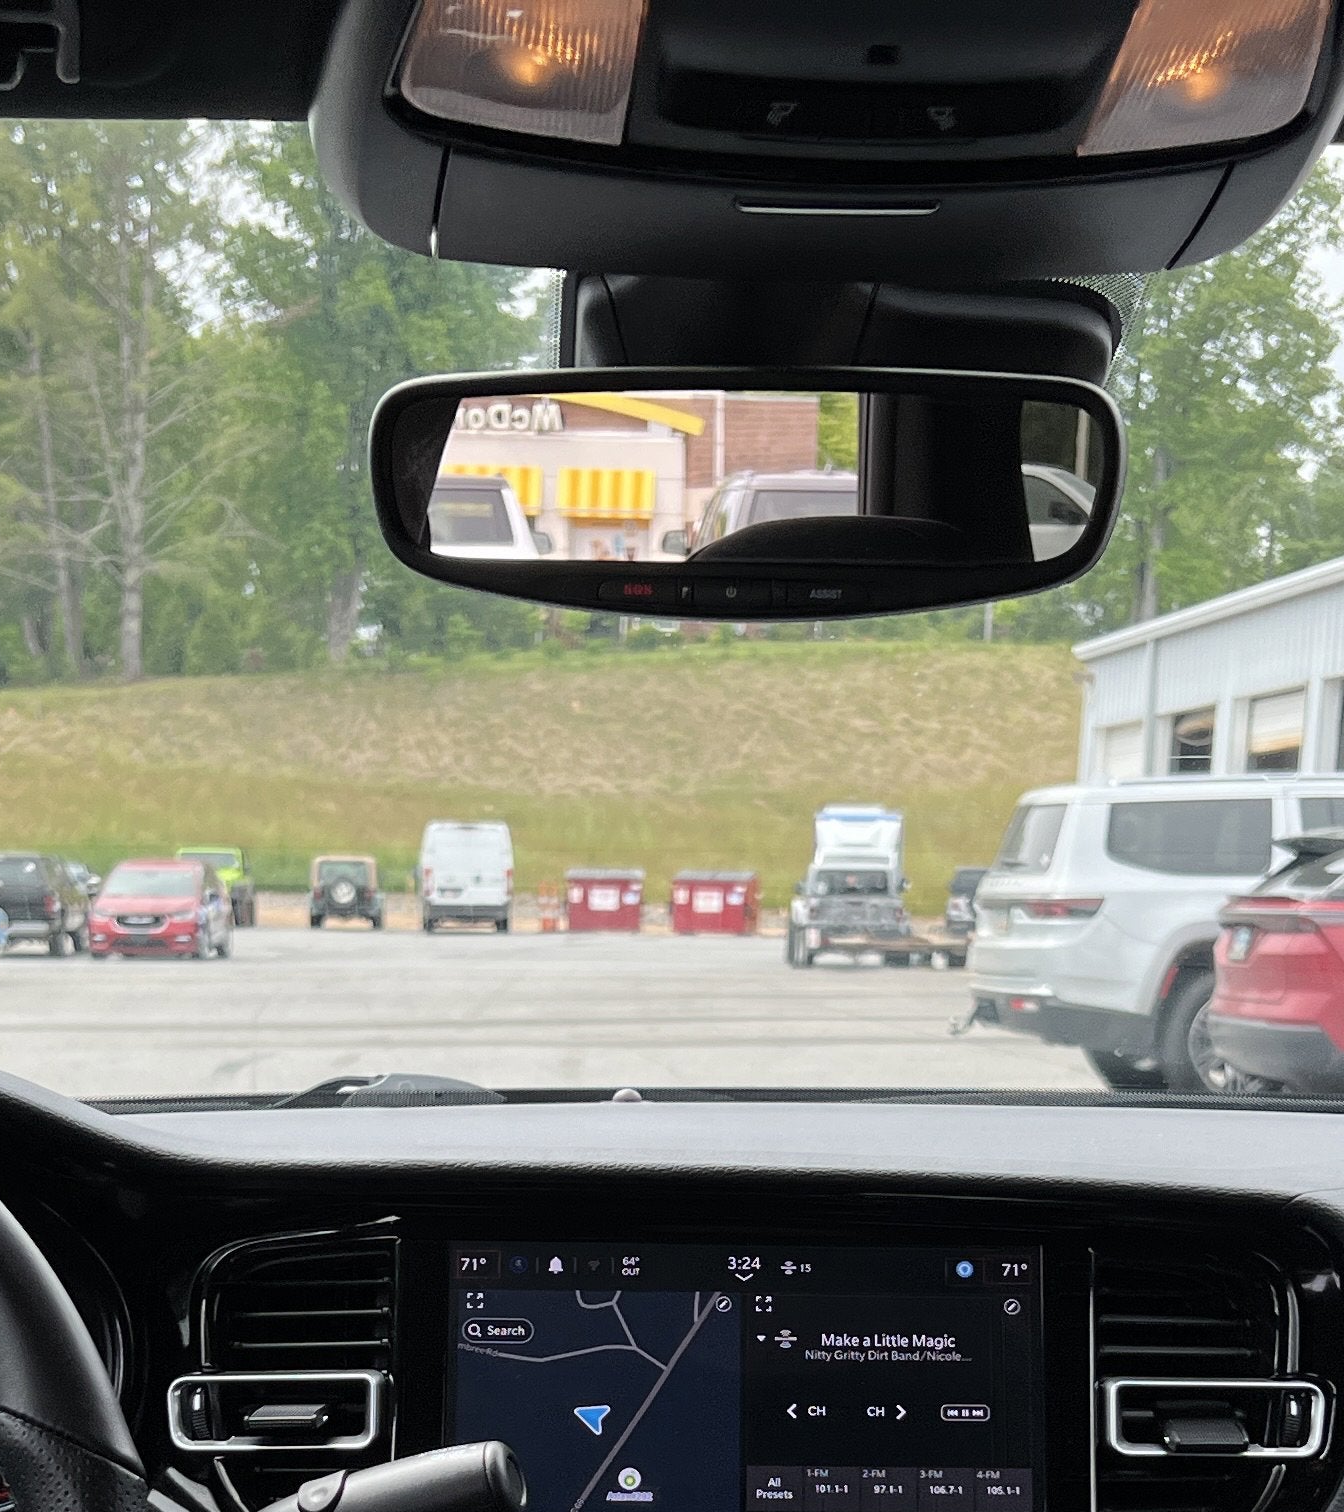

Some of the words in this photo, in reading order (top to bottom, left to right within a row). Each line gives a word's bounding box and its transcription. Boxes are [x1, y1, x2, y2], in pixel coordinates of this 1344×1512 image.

[460, 1257, 487, 1271] 71°
[622, 1256, 641, 1266] 64°
[727, 1256, 762, 1271] 3:24
[621, 1267, 641, 1277] OUT
[1001, 1262, 1029, 1277] 71°
[486, 1324, 526, 1337] Search
[820, 1333, 860, 1348] Make
[862, 1337, 871, 1348] a
[873, 1333, 909, 1348] Little
[912, 1332, 957, 1351] Magic
[804, 1349, 832, 1362] Nitty
[834, 1349, 866, 1362] Gritty
[867, 1350, 889, 1362] Dirt
[807, 1406, 827, 1418] CH
[866, 1406, 886, 1418] CH
[862, 1469, 887, 1479] 2-FM
[919, 1469, 944, 1479] 3-FM
[976, 1470, 1001, 1480] 4-FM
[767, 1476, 782, 1488] All
[755, 1488, 794, 1500] Presets
